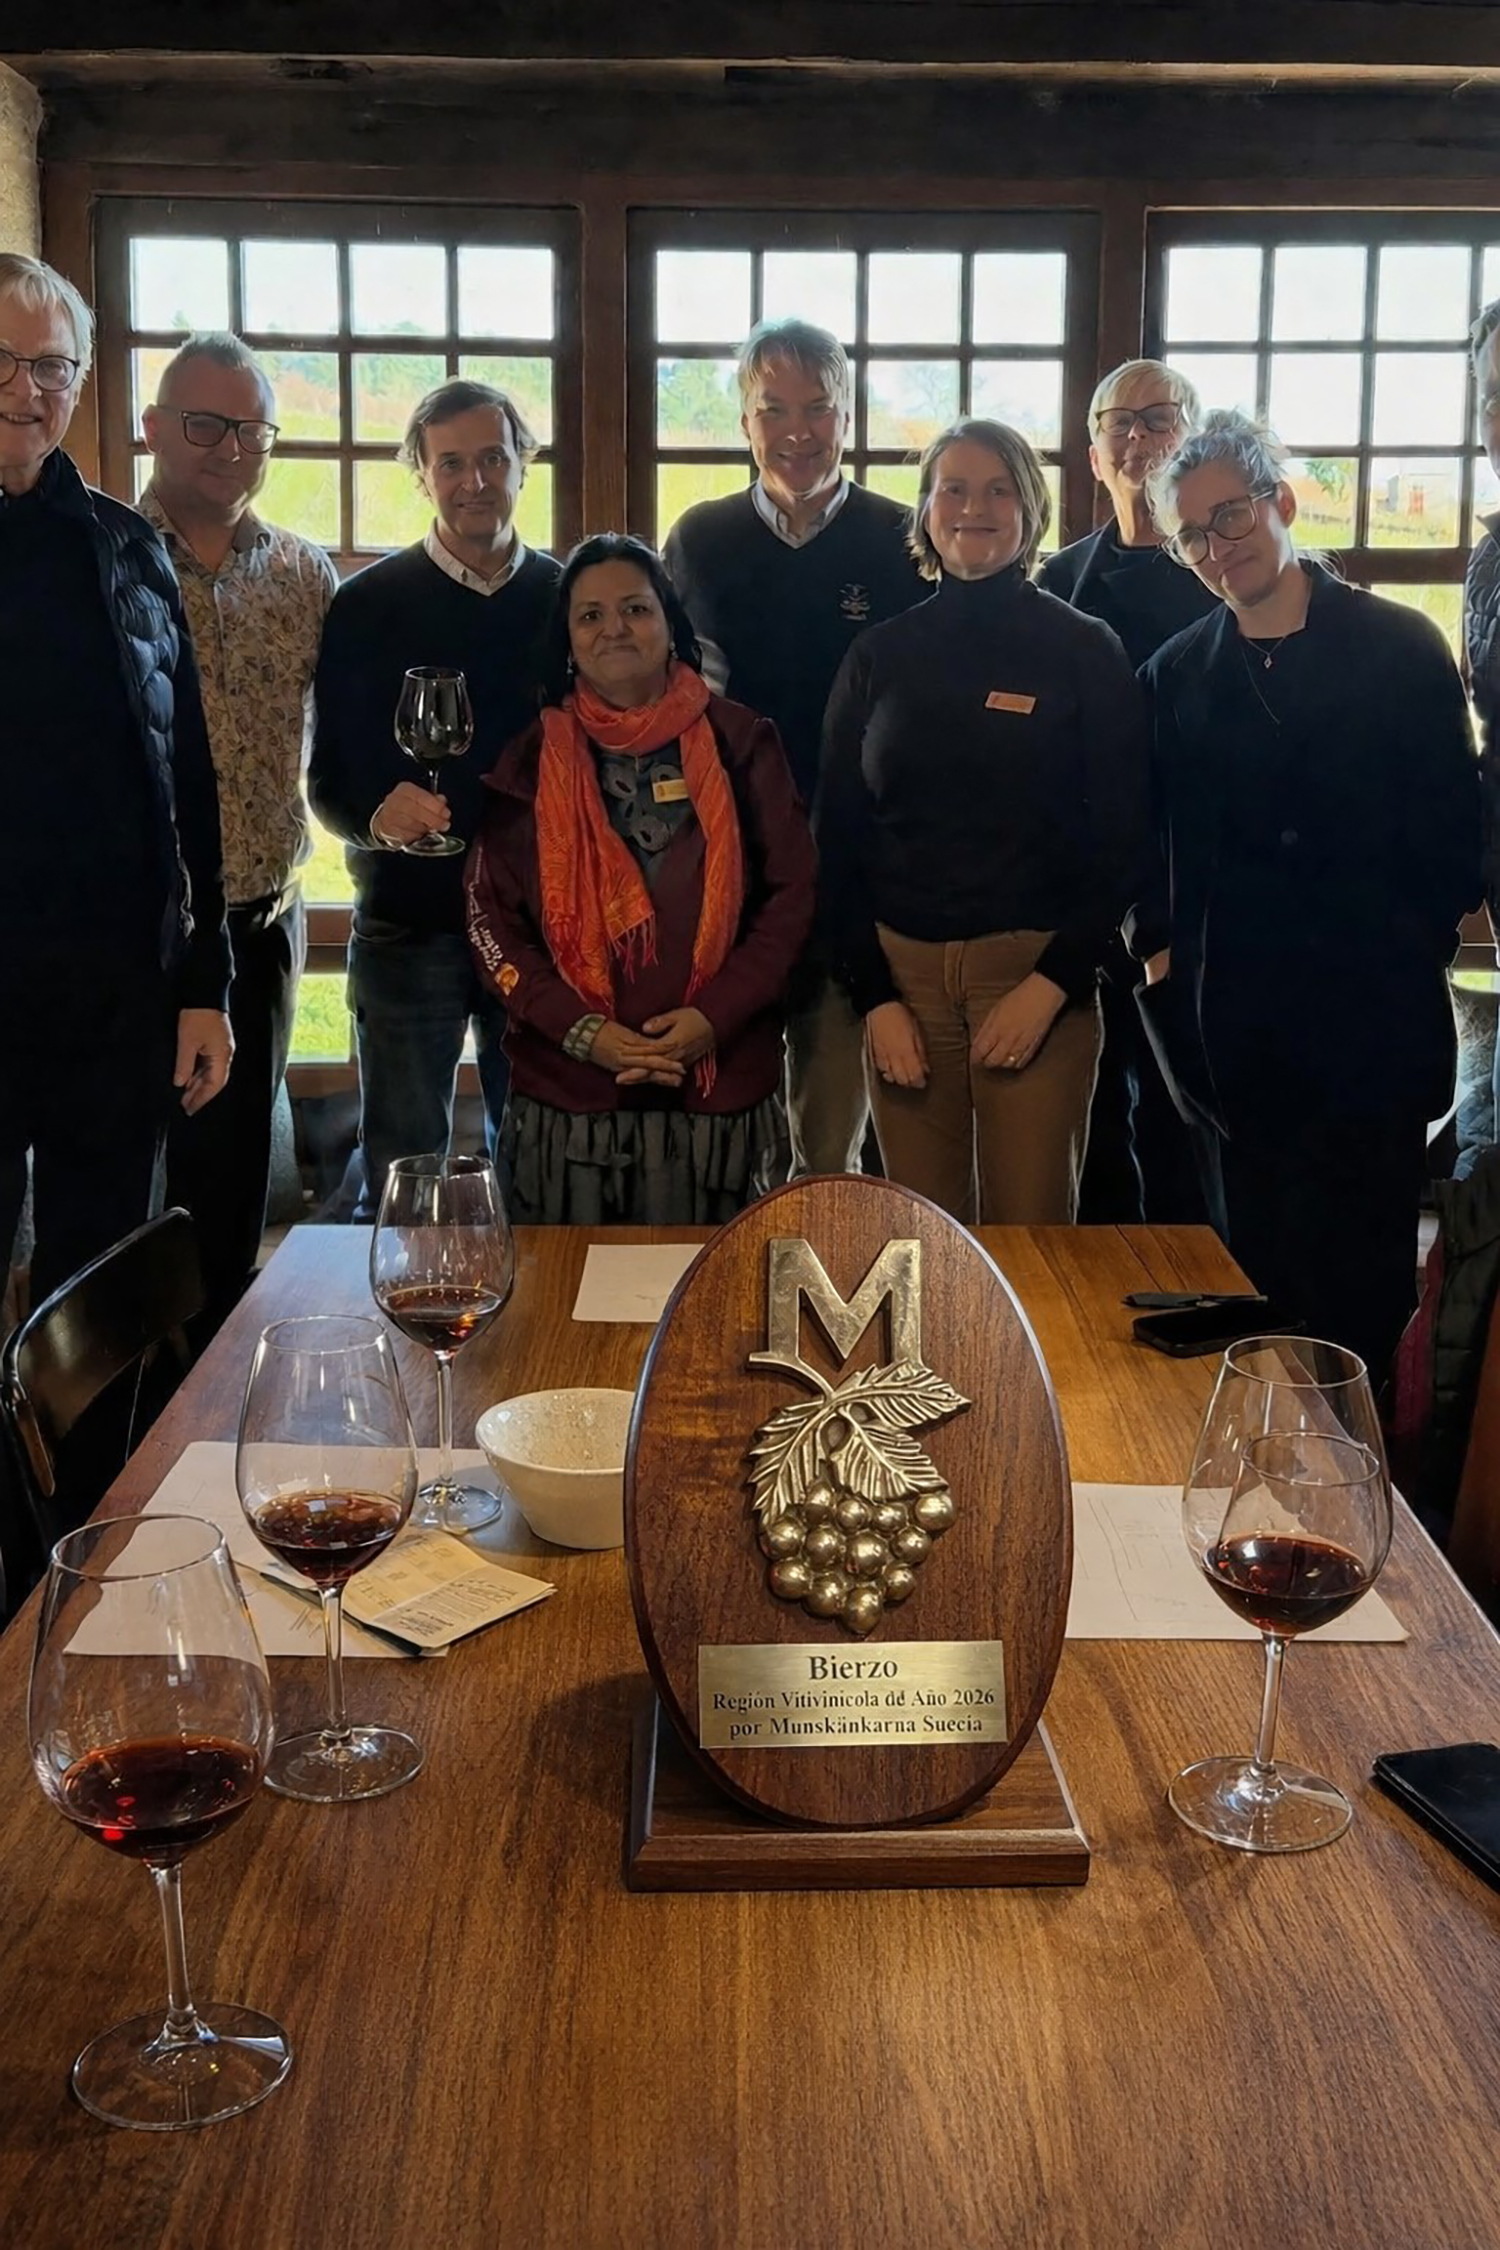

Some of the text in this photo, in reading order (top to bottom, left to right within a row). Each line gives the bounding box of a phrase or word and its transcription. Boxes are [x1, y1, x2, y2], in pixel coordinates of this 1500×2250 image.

[808, 1655, 898, 1680] Bierzo
[713, 1692, 775, 1714] Región
[911, 1689, 946, 1706] Año
[953, 1688, 995, 1706] 2026
[730, 1714, 983, 1740] por Munskänkarna Suecia
